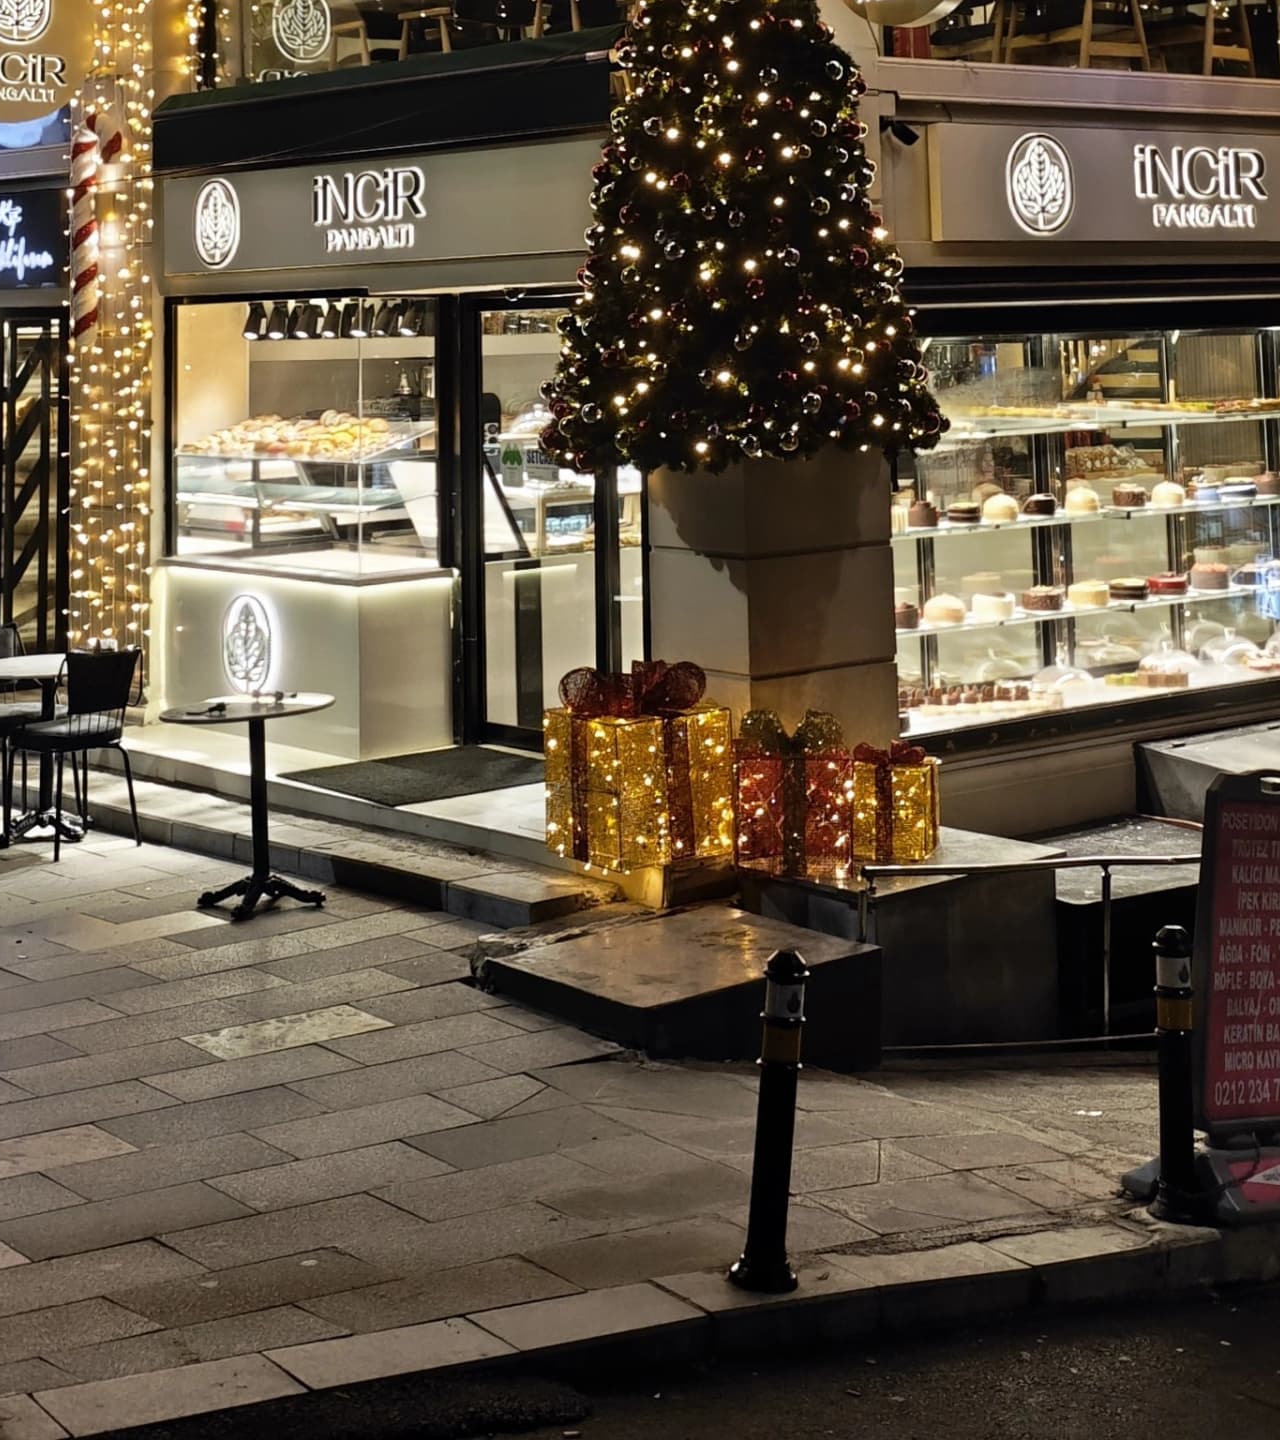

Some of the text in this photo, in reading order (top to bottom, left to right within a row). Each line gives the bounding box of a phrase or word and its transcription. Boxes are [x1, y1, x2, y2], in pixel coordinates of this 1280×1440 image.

[1153, 203, 1256, 229] PANGALTI
[1250, 970, 1275, 990] BOYA
[1214, 1080, 1246, 1106] 0212
[1248, 1078, 1270, 1105] 234
